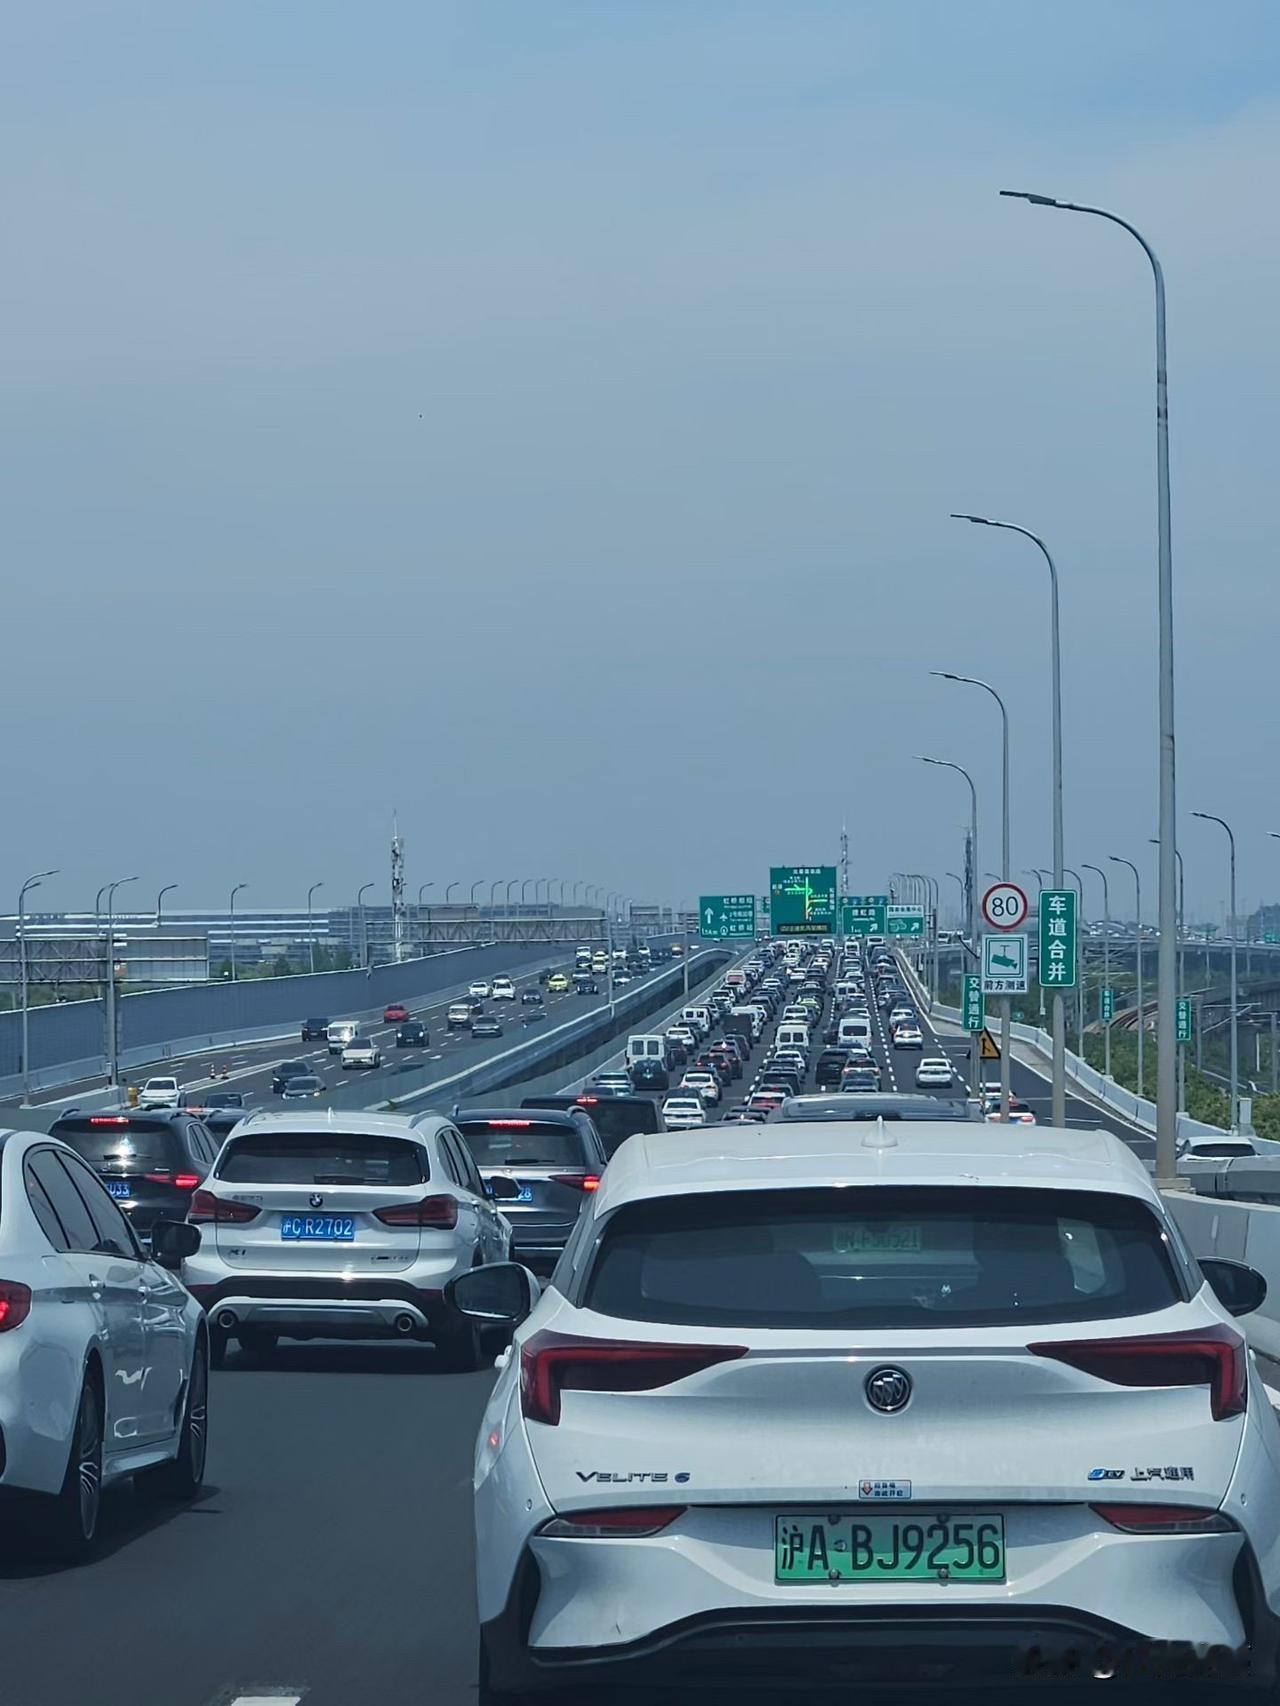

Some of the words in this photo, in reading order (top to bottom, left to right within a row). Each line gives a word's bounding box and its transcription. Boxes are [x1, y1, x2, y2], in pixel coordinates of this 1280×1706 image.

[992, 896, 1018, 917] 80
[1048, 896, 1067, 981] 车道合并
[984, 980, 1026, 991] 前方测速
[968, 977, 980, 1028] 交替通行
[575, 1471, 668, 1483] VELITE
[674, 1472, 691, 1483] 6
[1130, 1466, 1195, 1481] 上汽通用
